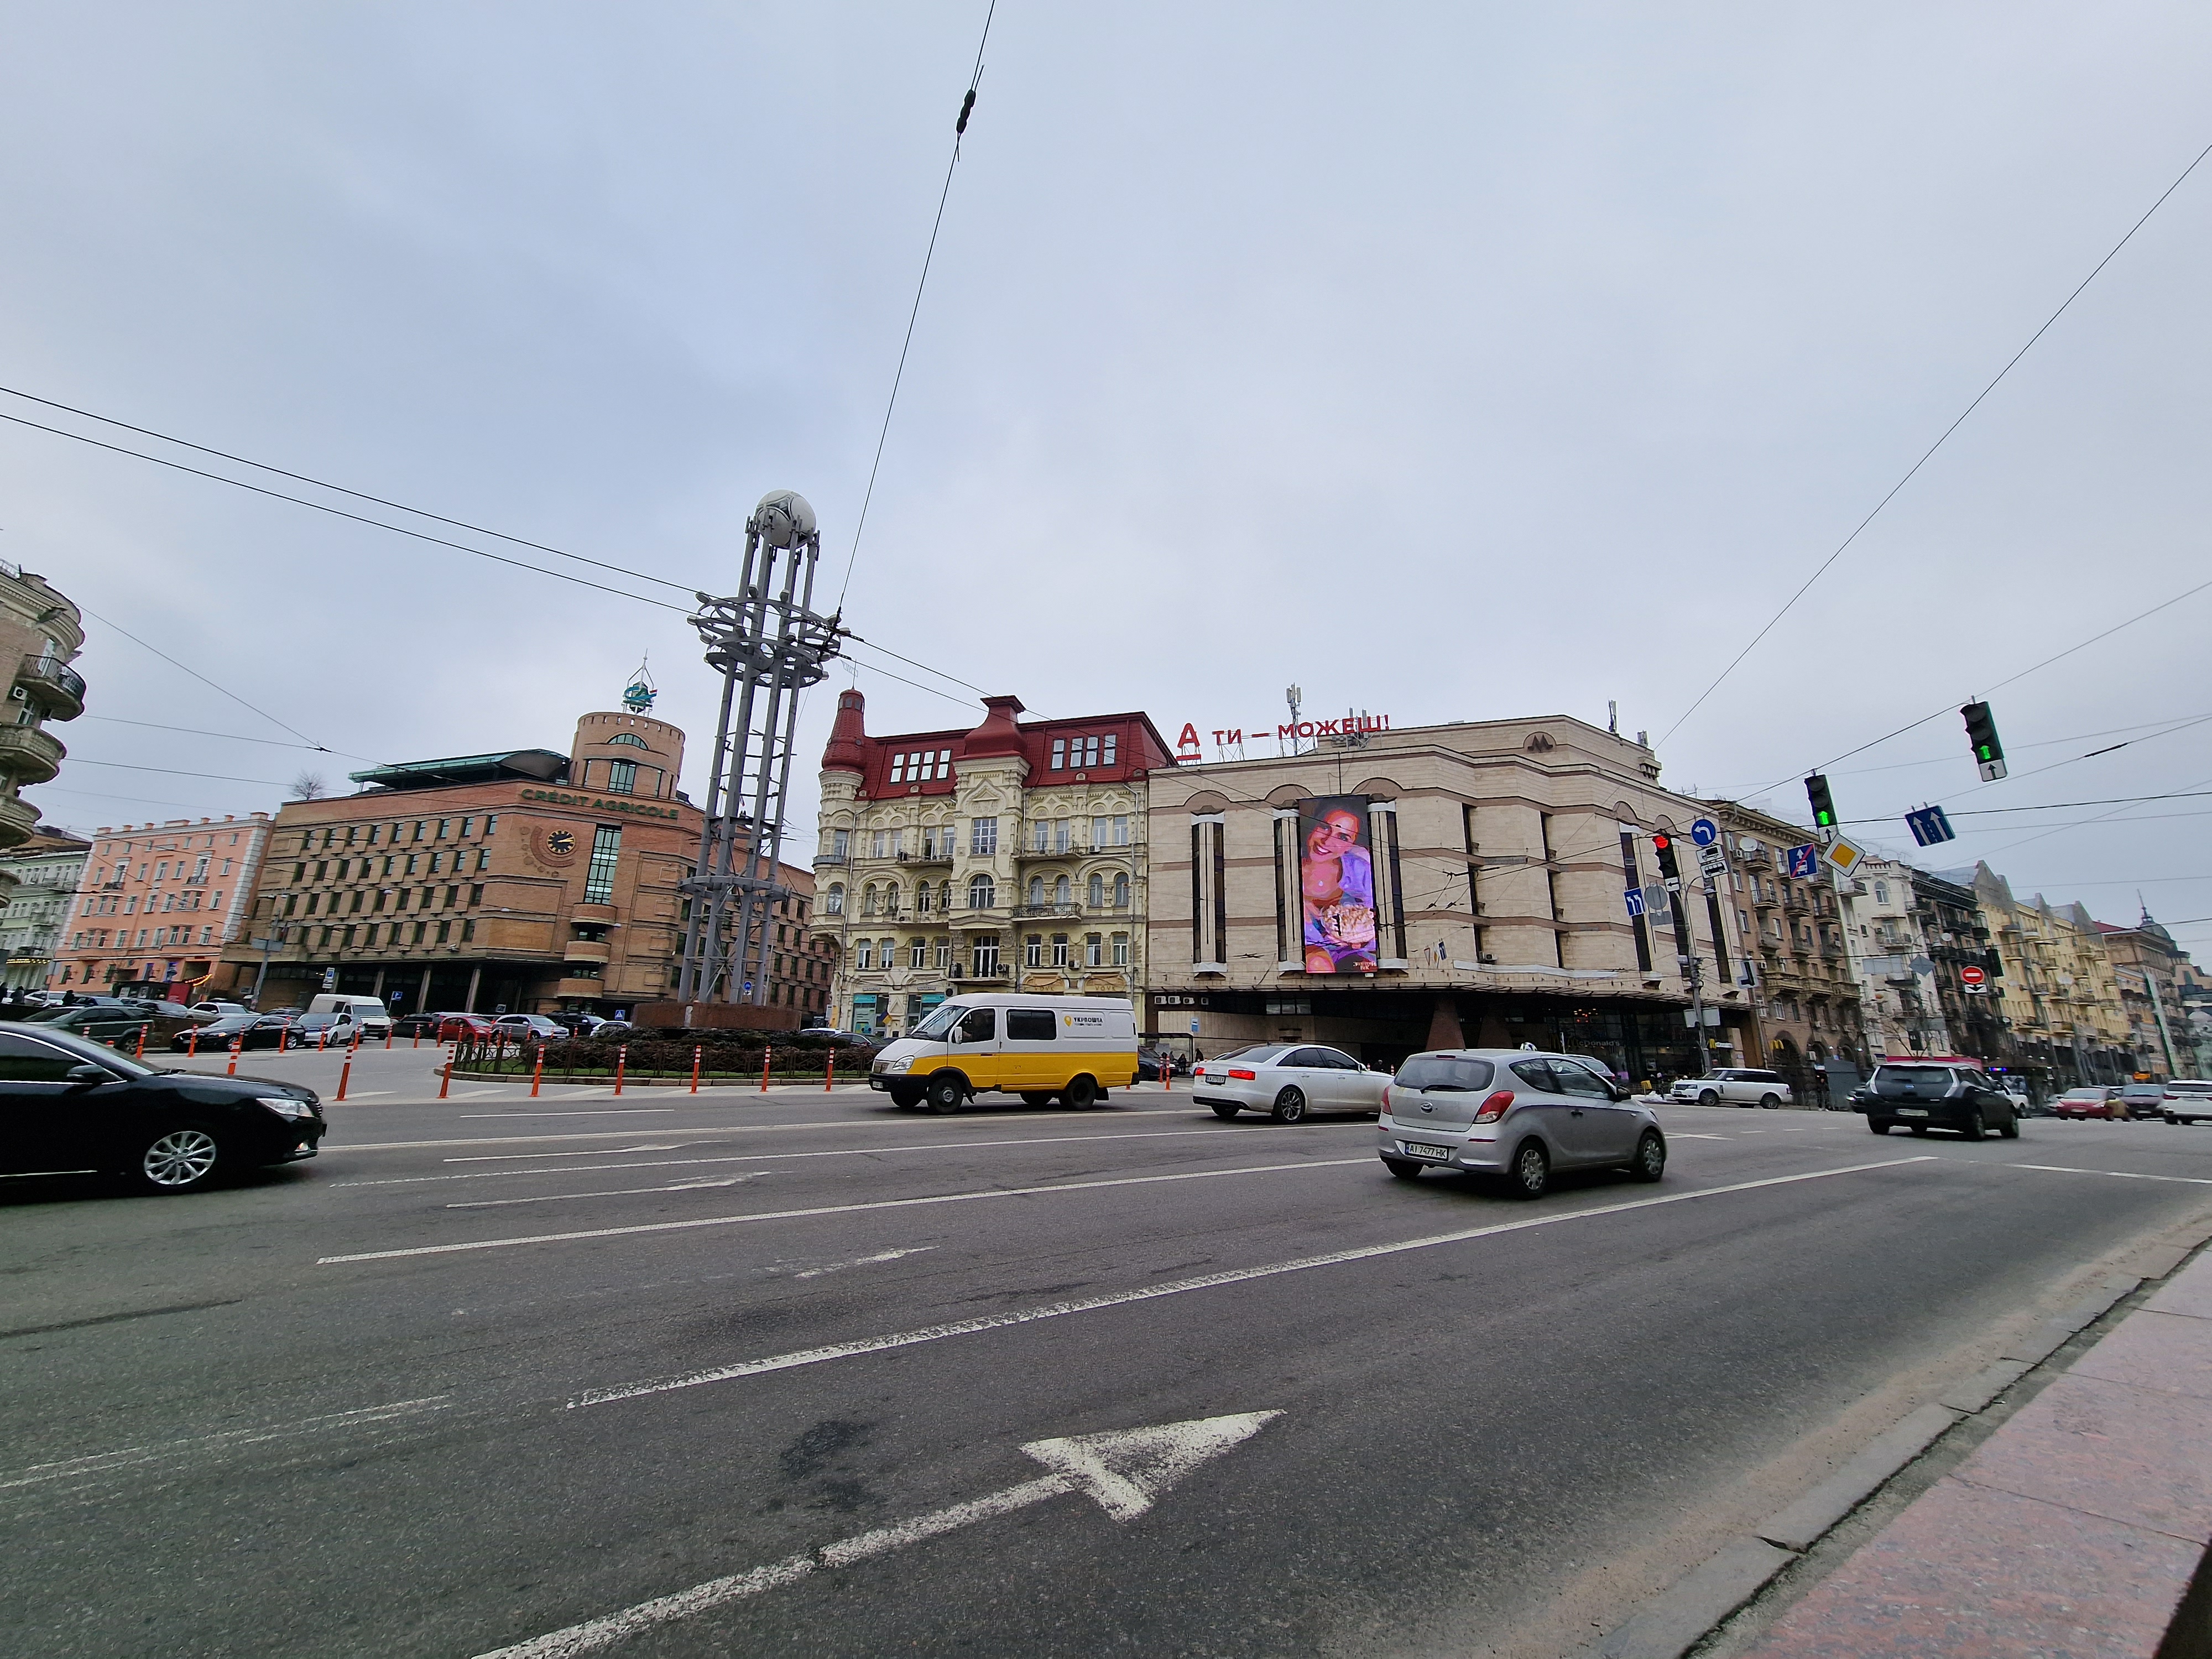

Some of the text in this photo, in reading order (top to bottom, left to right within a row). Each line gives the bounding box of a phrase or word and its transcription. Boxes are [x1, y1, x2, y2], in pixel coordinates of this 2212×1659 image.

[1278, 714, 1390, 740] МОЖЕШ!
[521, 788, 680, 820] CRÉDIT AGRICOLE
[1567, 1036, 1620, 1047] McDonald's
[1410, 1145, 1446, 1157] AI 7477 HK
